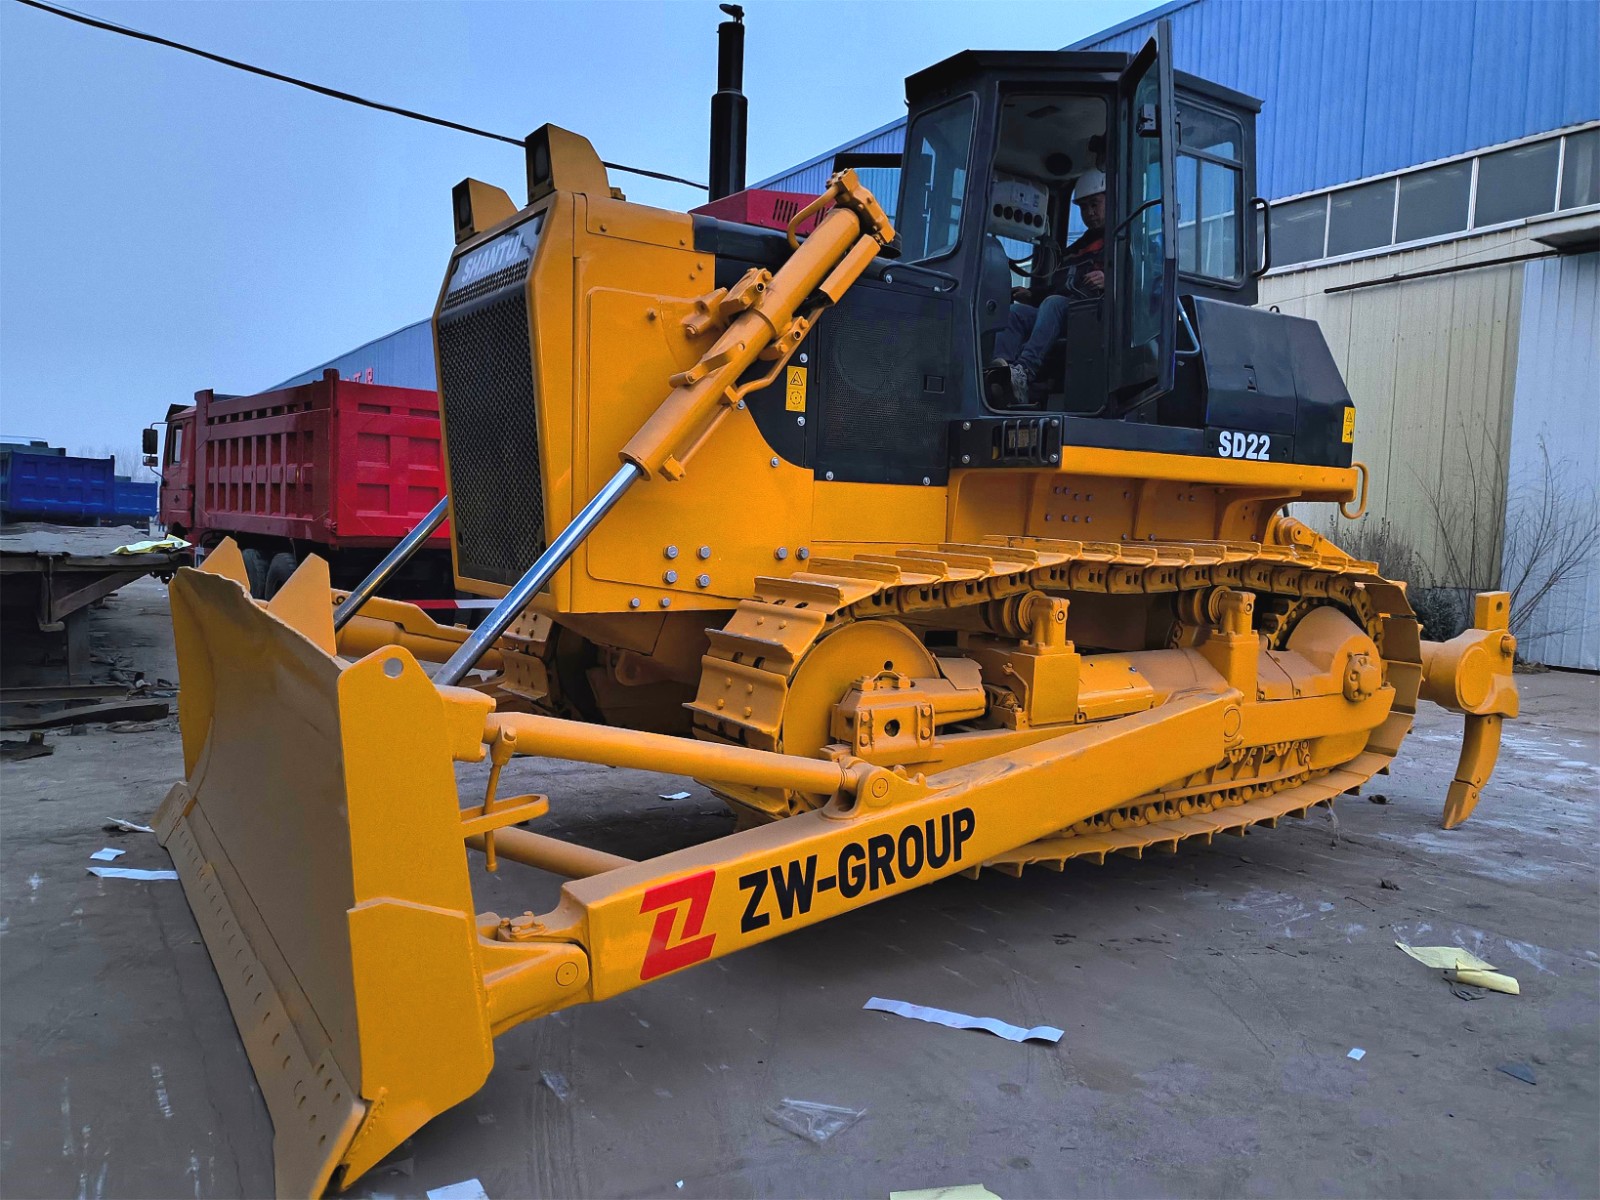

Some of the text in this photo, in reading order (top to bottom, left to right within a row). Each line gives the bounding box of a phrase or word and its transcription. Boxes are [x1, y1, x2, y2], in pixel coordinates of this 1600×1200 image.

[462, 234, 524, 282] SHANTUI
[1219, 431, 1270, 460] SD22
[739, 807, 975, 933] ZW-GROUP
